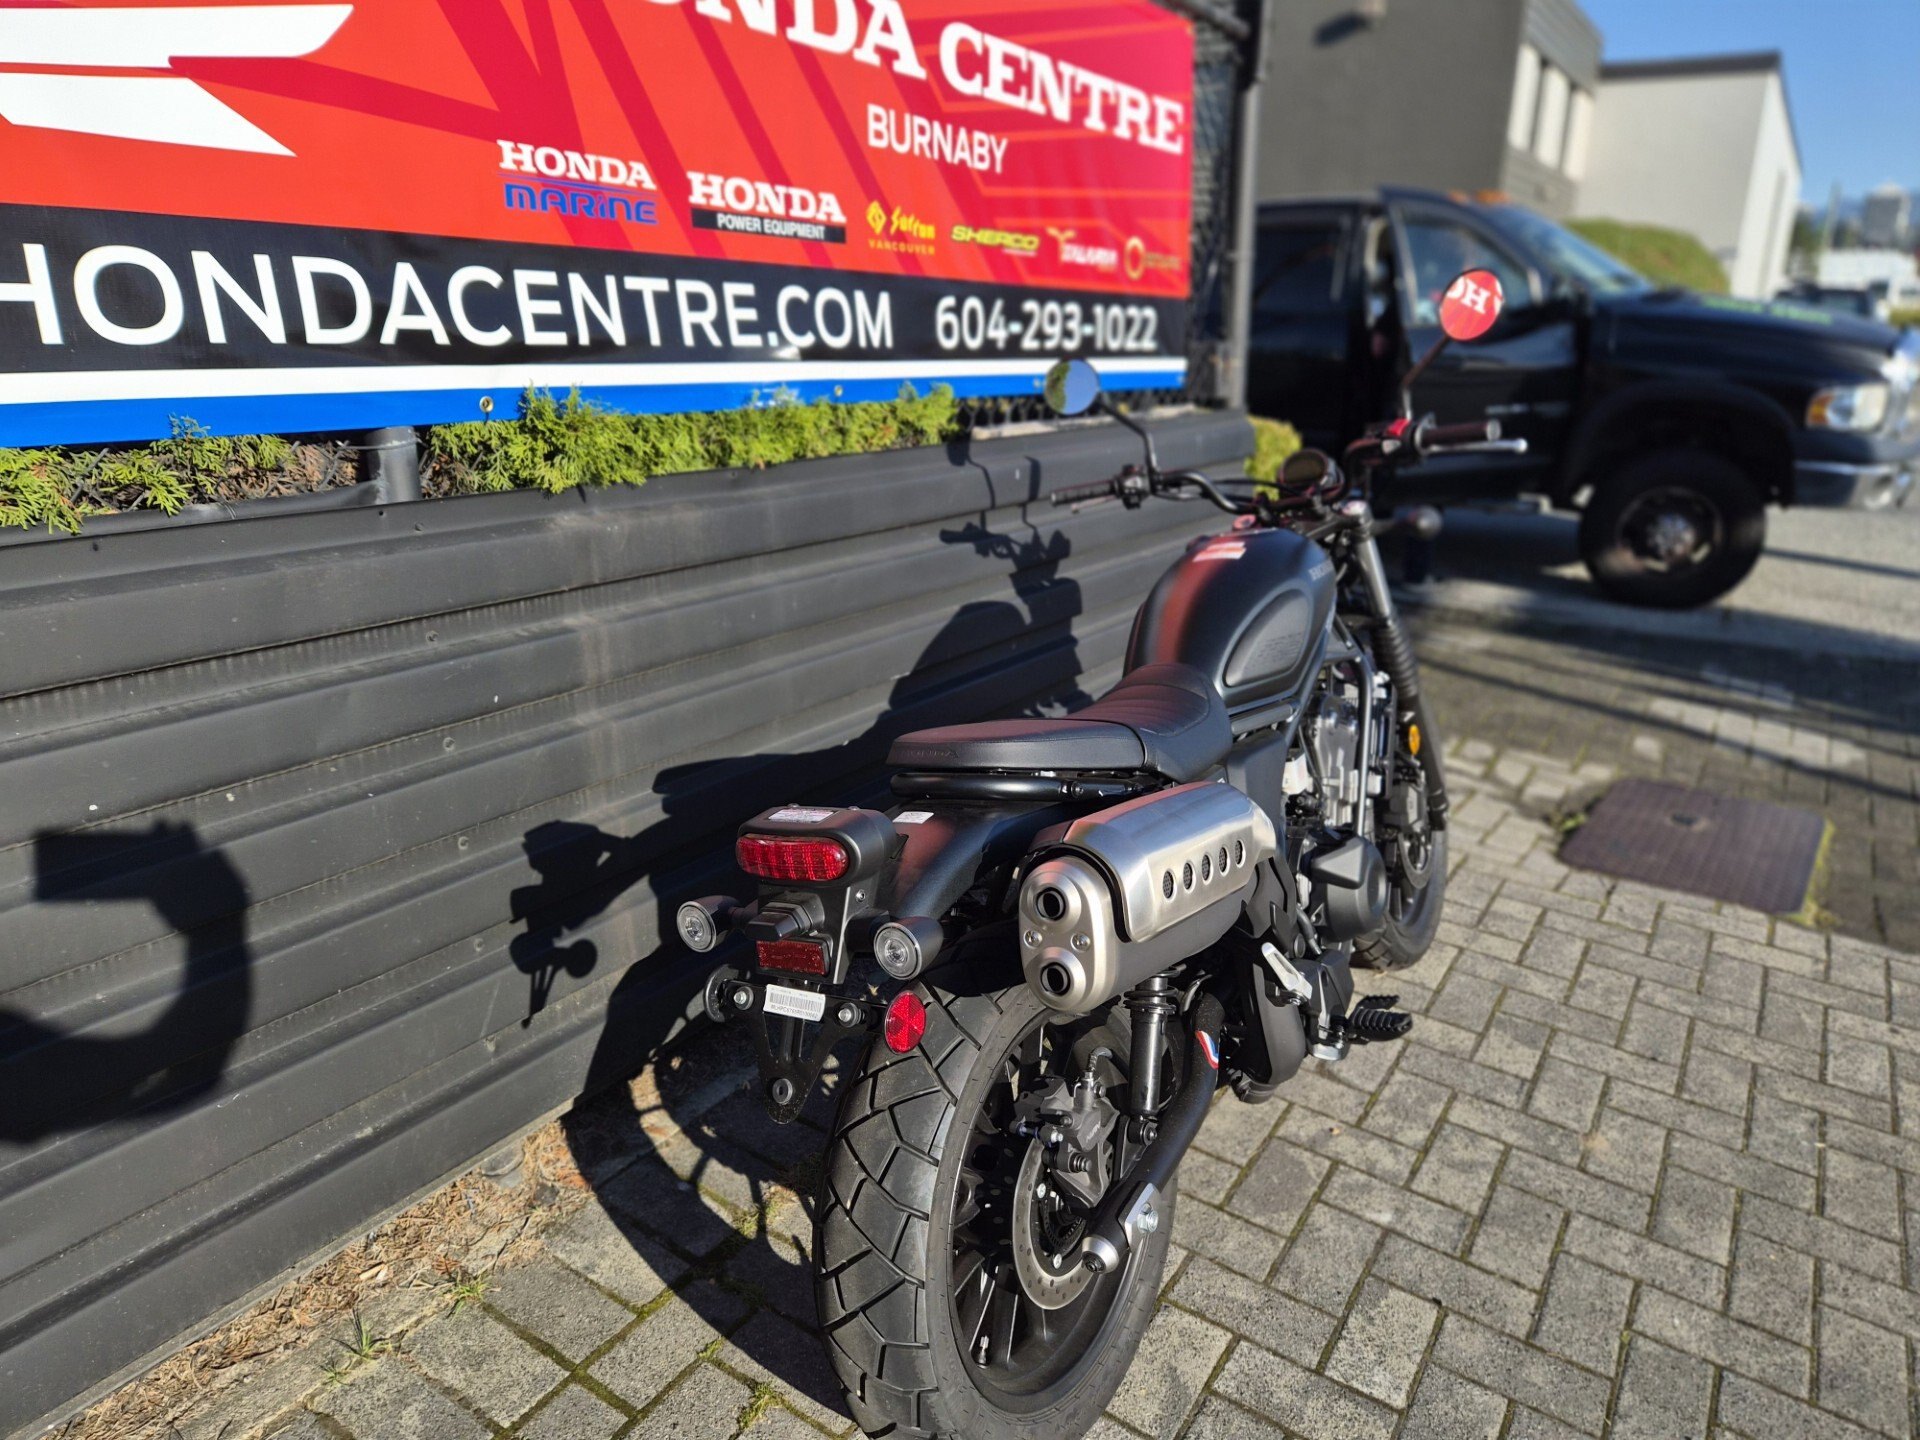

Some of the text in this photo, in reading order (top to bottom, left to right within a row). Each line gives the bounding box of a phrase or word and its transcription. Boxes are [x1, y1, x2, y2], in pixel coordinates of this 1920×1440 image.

[939, 22, 1184, 154] CENTRE
[496, 139, 657, 191] HONDA
[866, 104, 1008, 174] BURNABY
[686, 171, 847, 224] HONDA
[717, 213, 826, 241] POWER EQUIPMENT
[868, 238, 936, 256] VANCOUVER
[951, 225, 1040, 251] SHERCO
[0, 243, 894, 349] HONDACENTRE.COM
[936, 296, 1159, 352] 604-293-1022
